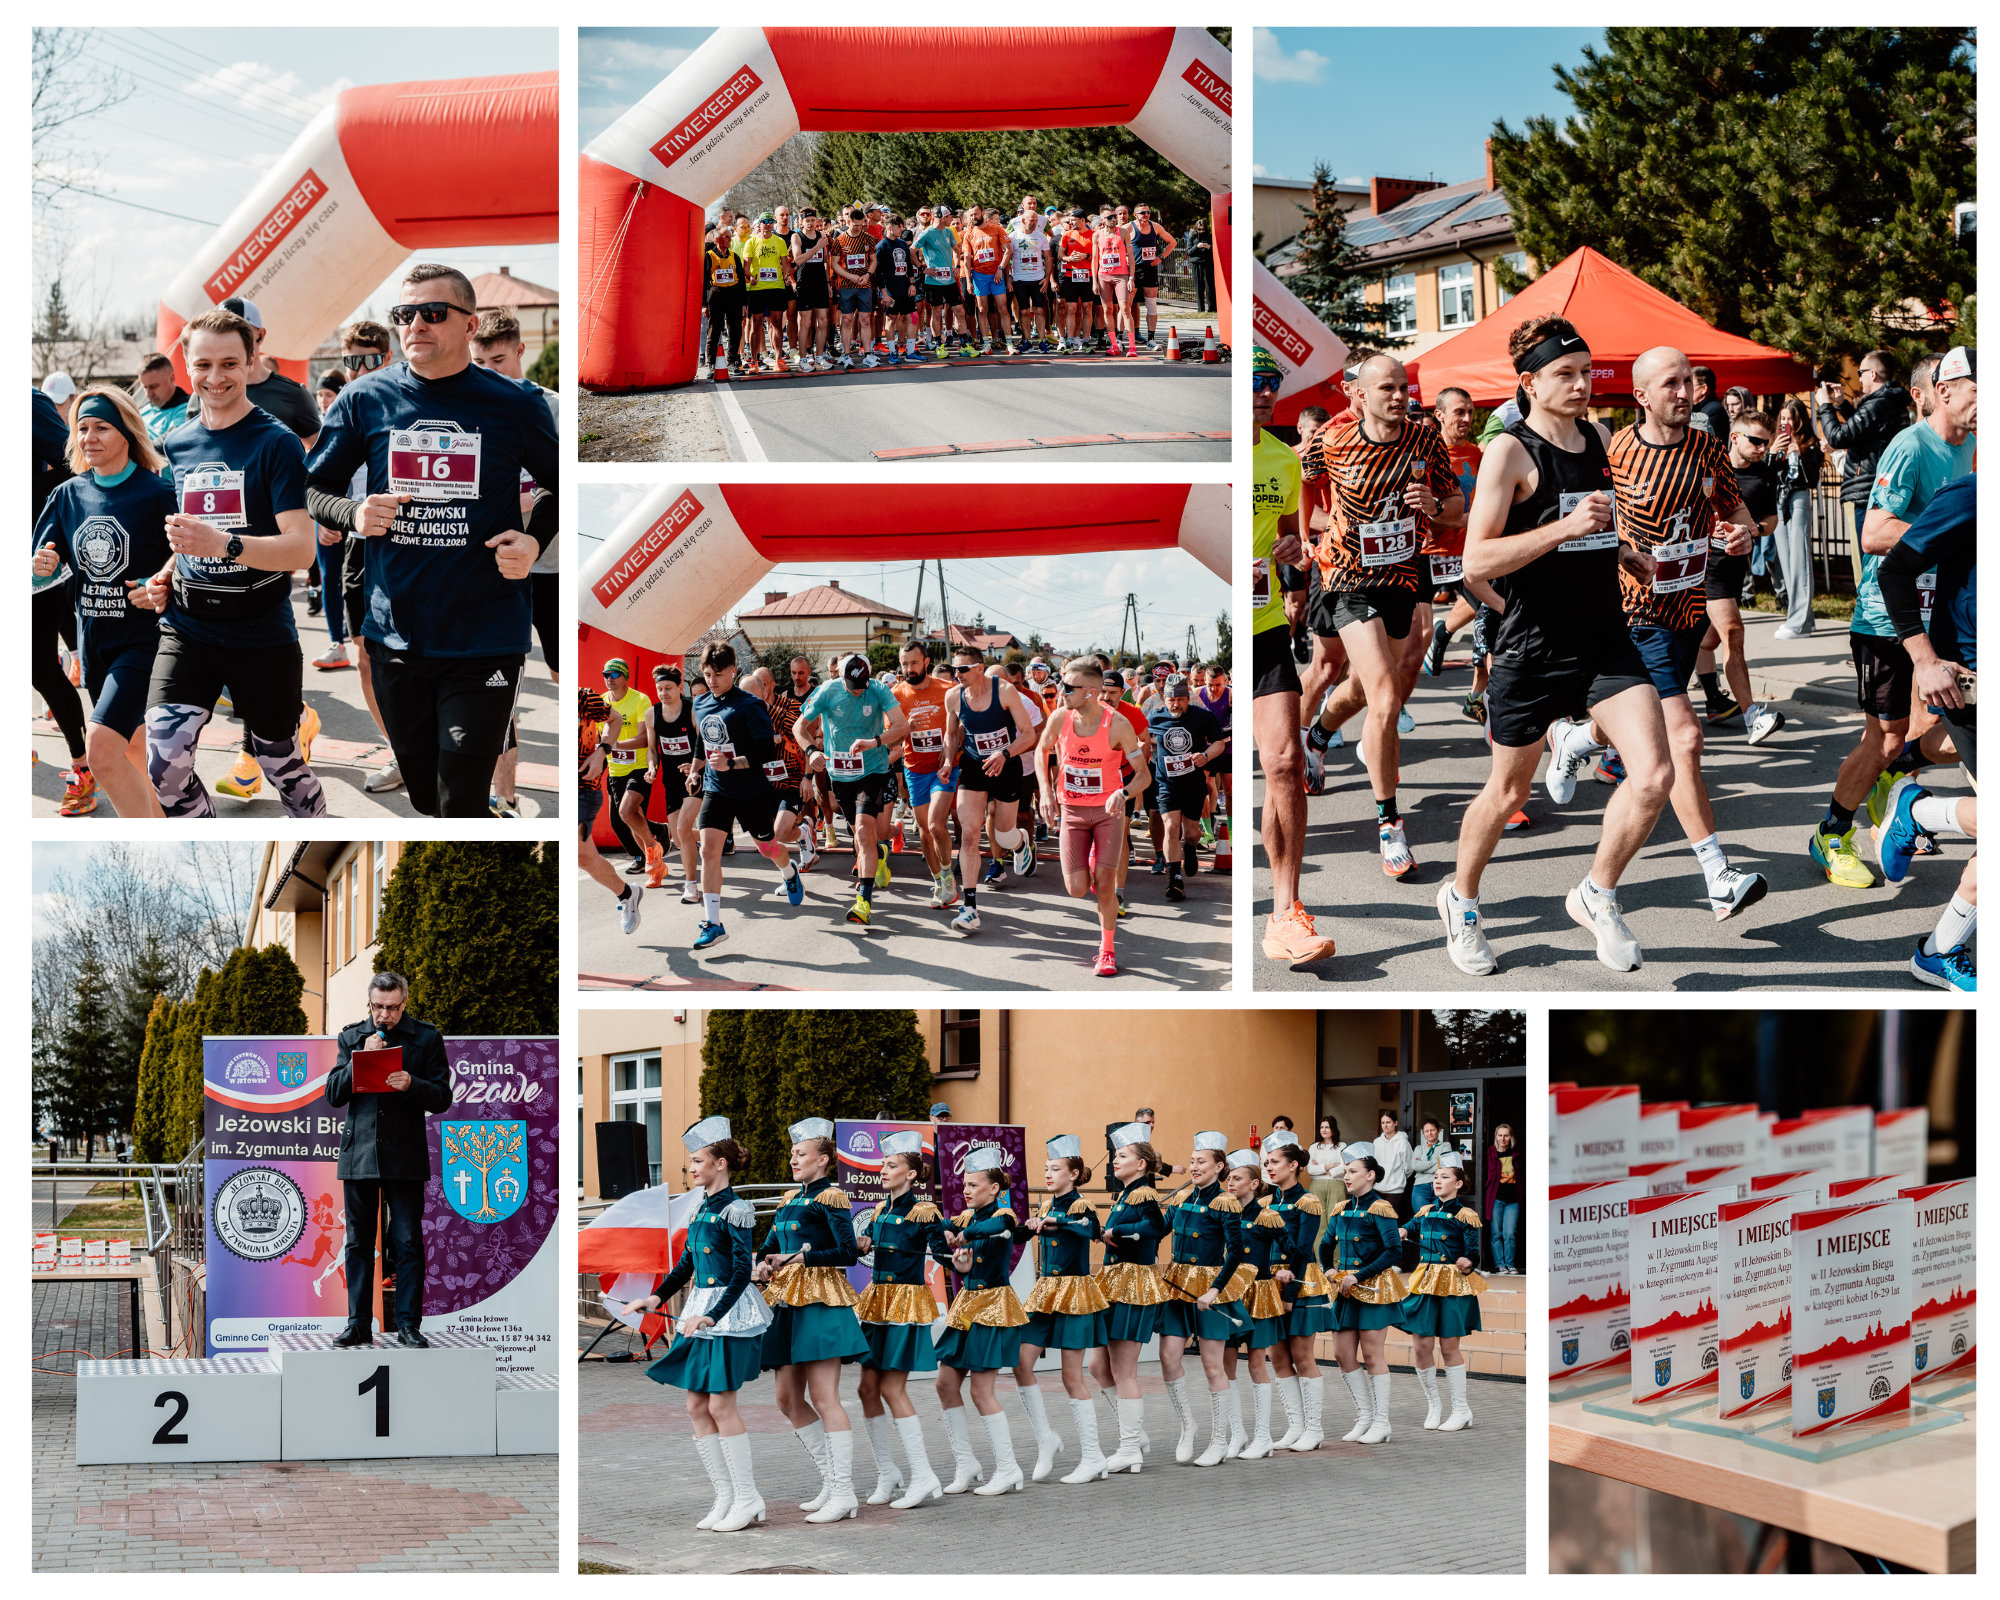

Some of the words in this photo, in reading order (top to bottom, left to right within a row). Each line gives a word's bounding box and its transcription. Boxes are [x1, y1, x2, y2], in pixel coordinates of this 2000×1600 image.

[1193, 66, 1232, 109] TIME
[659, 73, 755, 156] TIMEKEEPER
[705, 130, 726, 153] gdzie
[723, 115, 744, 134] liczy
[742, 105, 755, 118] się
[753, 90, 771, 108] czas
[1200, 107, 1223, 125] gdzie
[211, 179, 319, 293] TIMEKEEPER
[261, 257, 285, 285] gdzie
[282, 235, 307, 260] liczy
[304, 221, 321, 238] się
[318, 200, 339, 223] czas
[417, 455, 451, 479] 16
[203, 492, 216, 513] 8
[407, 505, 466, 520] JEŻOWSKI
[391, 520, 415, 534] BIEG
[417, 522, 469, 535] AUGUSTA
[391, 534, 421, 545] JEŻOWE
[422, 538, 467, 547] 22.03.2026
[600, 498, 695, 595] TIMEKEEPER
[1374, 534, 1407, 553] 128
[644, 566, 666, 590] gdzie
[663, 547, 684, 569] liczy
[682, 535, 697, 549] się
[694, 517, 713, 537] czas
[208, 564, 248, 574] 22.03.2026
[1440, 561, 1462, 575] 126
[1678, 559, 1690, 577] 7
[920, 738, 934, 747] 15
[983, 738, 1003, 749] 132
[617, 751, 628, 760] 73
[841, 760, 854, 769] 14
[769, 768, 774, 776] 7
[1172, 761, 1185, 770] 98
[1074, 776, 1089, 786] 81
[232, 1052, 258, 1063] CENTRUM
[257, 1055, 271, 1079] KULTURY
[456, 1060, 514, 1075] Gmina
[215, 1114, 311, 1134] Jeżowski
[317, 1116, 345, 1135] Bie
[211, 1141, 232, 1154] im.
[235, 1141, 309, 1158] Zygmunta
[312, 1144, 340, 1160] Aug
[970, 1139, 1001, 1150] Gmina
[1582, 1139, 1625, 1156] MIEJSCE
[230, 1173, 271, 1194] JEŻOWSKI
[274, 1178, 293, 1196] BIEG
[845, 1172, 883, 1185] Jeżow
[1560, 1208, 1565, 1225] I
[1569, 1201, 1628, 1224] MIEJSCE
[1917, 1211, 1921, 1228] I
[1924, 1203, 1969, 1226] MIEJSCE
[1652, 1221, 1657, 1238] I
[1661, 1212, 1718, 1237] MIEJSCE
[220, 1221, 228, 1235] IM.
[227, 1232, 270, 1253] ZYGMUNTA
[273, 1220, 299, 1250] AUGUSTA
[1554, 1238, 1561, 1246] w
[1563, 1235, 1569, 1245] II
[1571, 1230, 1610, 1244] Jeżowskim
[1738, 1229, 1743, 1246] I
[1817, 1239, 1822, 1257] I
[1827, 1228, 1891, 1255] MIEJSCE
[1919, 1238, 1924, 1248] II
[1925, 1232, 1955, 1246] Jeżowskim
[1956, 1230, 1972, 1240] Biegu
[1553, 1249, 1565, 1259] im.
[1567, 1245, 1604, 1259] Zygmunta
[1656, 1249, 1662, 1259] II
[1664, 1242, 1701, 1258] Jeżowskim
[1741, 1257, 1747, 1268] II
[1749, 1250, 1782, 1266] Jeżowskim
[1922, 1247, 1950, 1261] Zygmunta
[1950, 1243, 1972, 1255] Augusta
[1553, 1260, 1582, 1273] kategorii
[1583, 1257, 1614, 1269] mężczyzn
[1647, 1265, 1659, 1275] im.
[1660, 1259, 1695, 1273] Zygmunta
[1810, 1273, 1818, 1281] w
[1820, 1269, 1827, 1280] II
[1828, 1262, 1870, 1279] Jeżowskim
[1872, 1259, 1894, 1271] Biegu
[1646, 1274, 1674, 1289] kategorii
[1674, 1270, 1704, 1283] mężczyzn
[1733, 1274, 1744, 1284] im.
[1745, 1267, 1777, 1282] Zygmunta
[1732, 1284, 1758, 1298] kategorii
[1758, 1279, 1785, 1293] mężczyzn
[1809, 1286, 1822, 1297] im.
[1824, 1279, 1863, 1296] Zygmunta
[1864, 1273, 1895, 1287] Augusta
[1812, 1296, 1845, 1311] kategorii
[1846, 1292, 1868, 1305] kobiet
[1870, 1287, 1890, 1300] 16-29
[1891, 1286, 1900, 1296] lat
[458, 1315, 482, 1323] Gmina
[483, 1315, 509, 1324] Jeżowe
[1824, 1315, 1844, 1326] Jeżowe,
[1852, 1312, 1868, 1320] marca
[1868, 1308, 1882, 1318] 2026
[268, 1322, 323, 1332] Organizator:
[476, 1325, 501, 1333] Jeżowe
[215, 1334, 250, 1343] Gminne
[251, 1333, 269, 1342] Cen
[494, 1345, 536, 1353] @jezowe.pl
[358, 1365, 390, 1437] 1
[152, 1390, 189, 1445] 2
